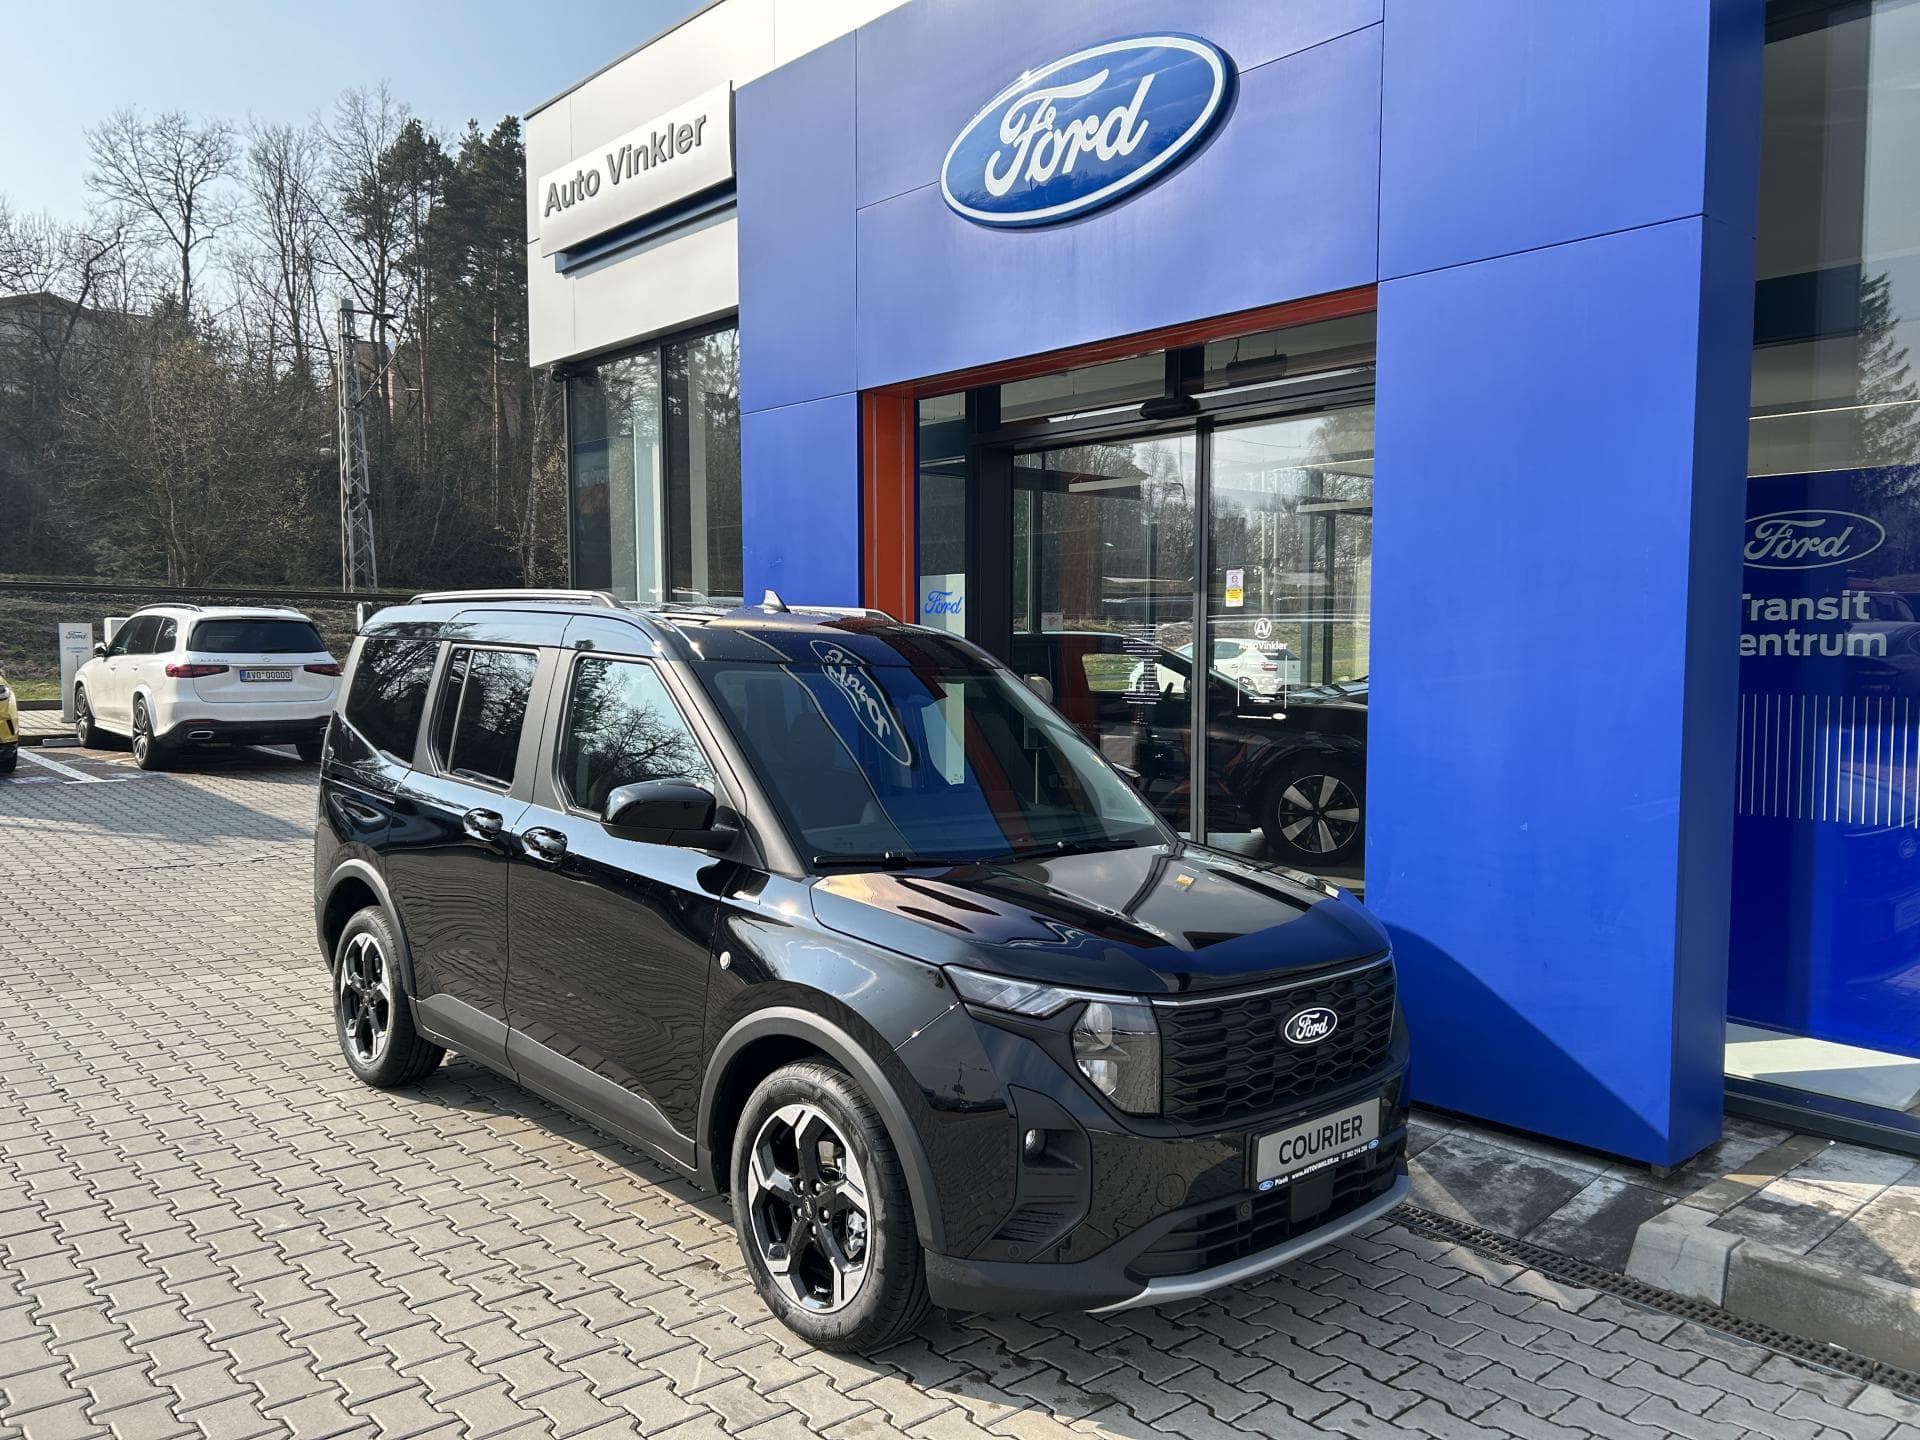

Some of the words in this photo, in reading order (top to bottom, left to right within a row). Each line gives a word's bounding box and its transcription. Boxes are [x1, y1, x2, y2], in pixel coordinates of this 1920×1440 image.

[984, 68, 1156, 197] Ford
[543, 169, 601, 217] Auto
[606, 114, 707, 185] Vinkler
[1743, 519, 1854, 560] Ford
[924, 590, 963, 615] Ford
[1739, 628, 1887, 657] entrum
[1296, 1013, 1328, 1040] Ford
[1279, 1115, 1363, 1165] COURIER
